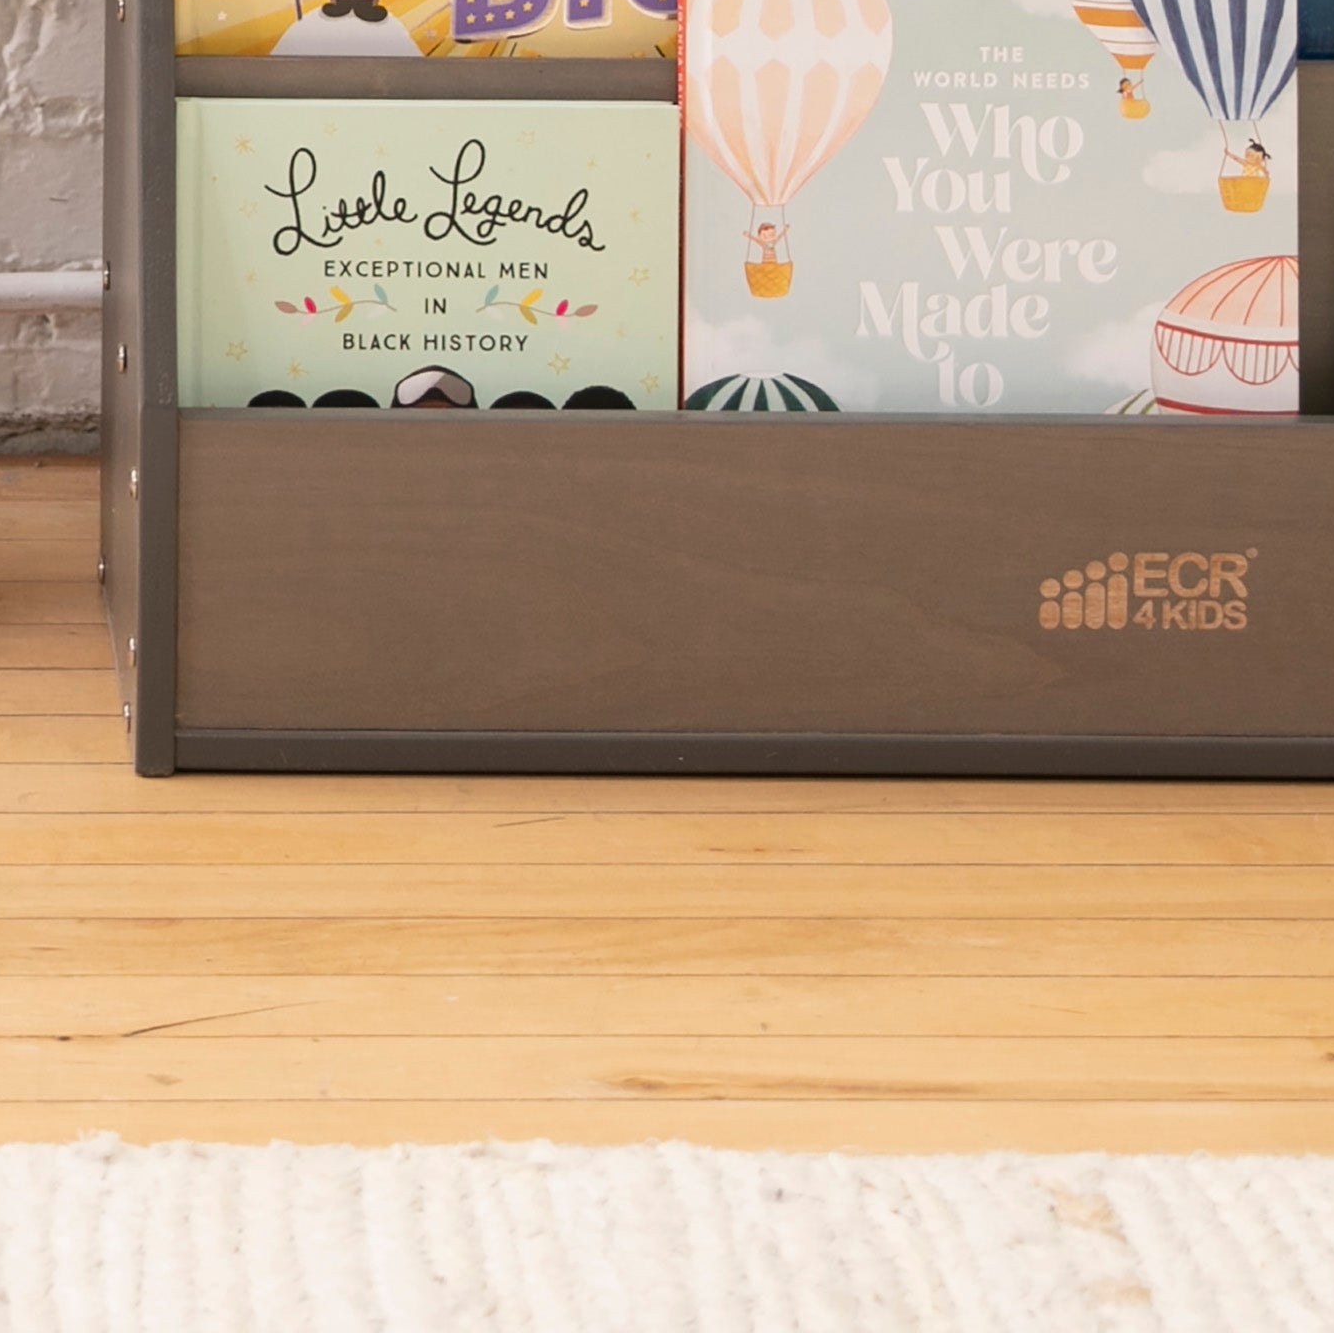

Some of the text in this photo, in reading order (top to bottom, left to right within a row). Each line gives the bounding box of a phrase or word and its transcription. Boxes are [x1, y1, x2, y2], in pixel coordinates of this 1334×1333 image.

[913, 70, 1090, 89] WORLD NEEDS
[980, 47, 1024, 63] THE
[919, 102, 1084, 184] Who
[264, 139, 606, 255] Little Legends
[882, 156, 1011, 213] You
[324, 260, 548, 279] EXCEPTIONAL MEN
[934, 226, 1118, 283] Were
[425, 298, 446, 314] IN
[856, 281, 1050, 363] Made
[343, 333, 529, 352] BLACK HISTORY
[938, 355, 1004, 408] to
[1133, 552, 1249, 598] ECR
